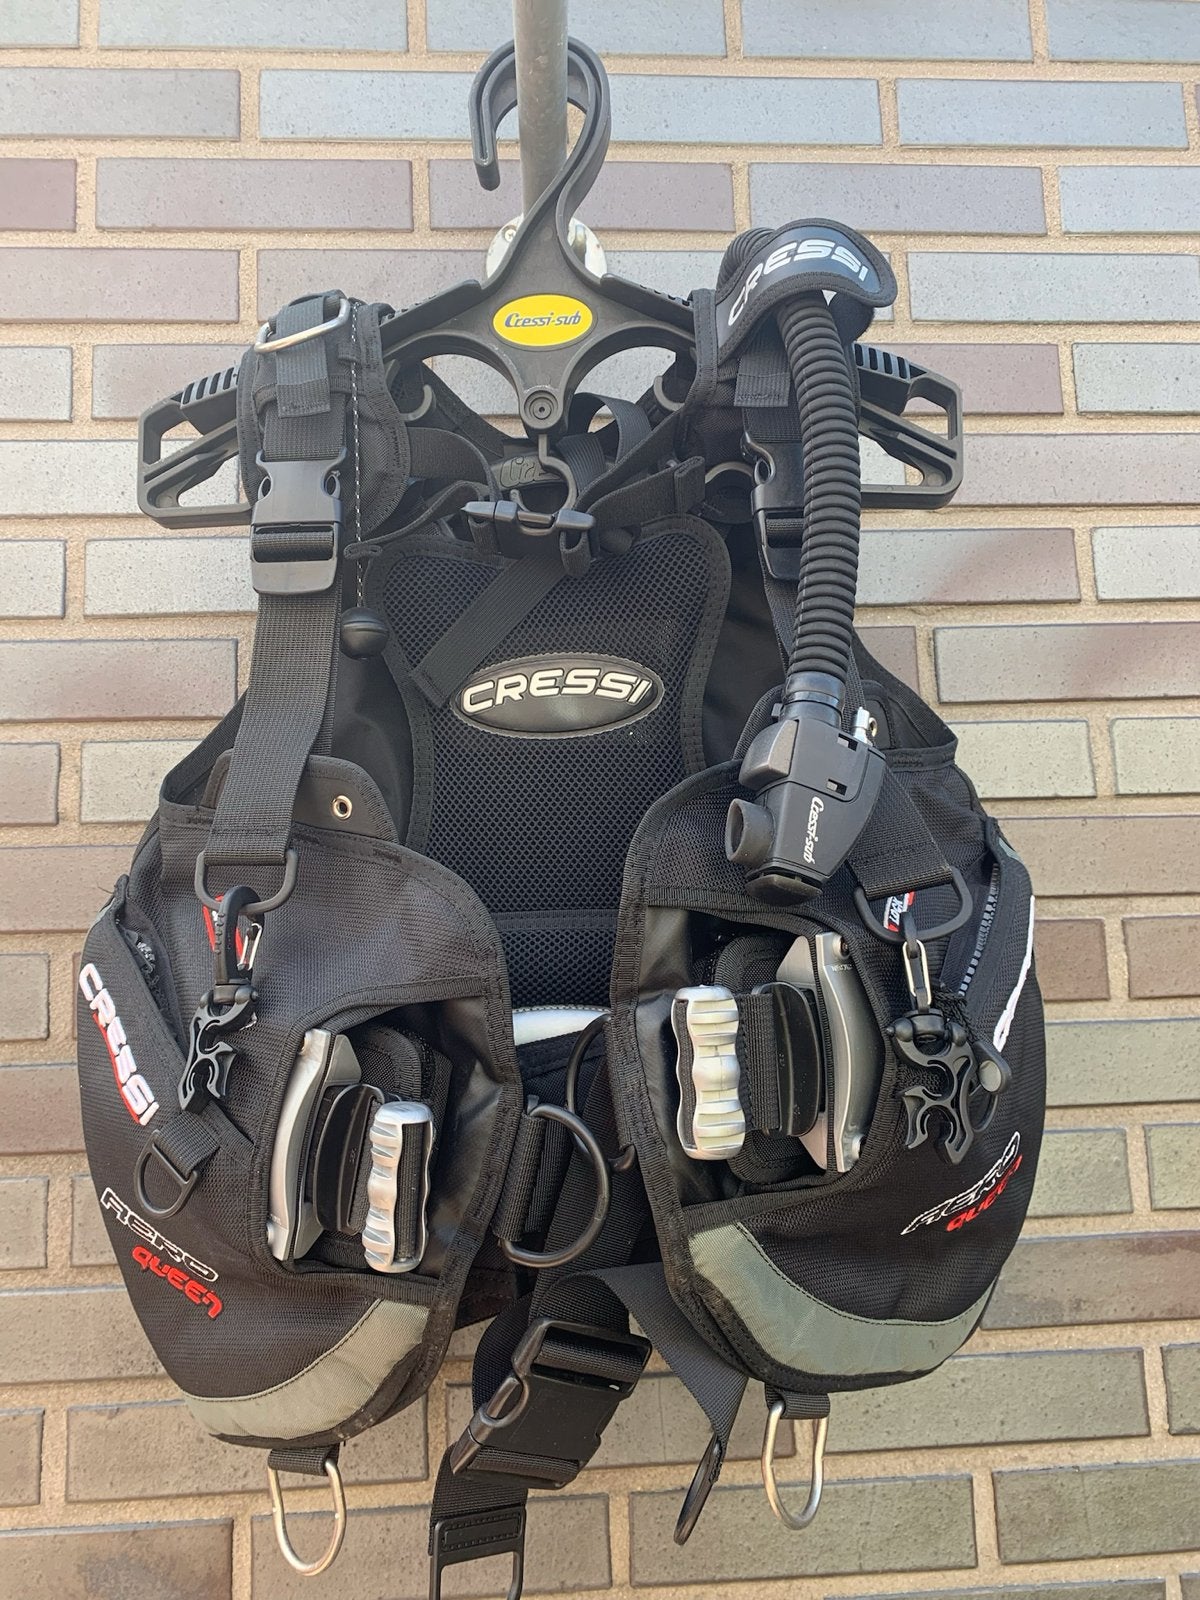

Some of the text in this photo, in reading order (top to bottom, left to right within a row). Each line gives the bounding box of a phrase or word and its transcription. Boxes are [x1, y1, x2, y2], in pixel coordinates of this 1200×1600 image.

[505, 311, 581, 328] Cressi-sub
[728, 239, 868, 326] CRESSI
[463, 668, 652, 714] CRESSI
[803, 796, 824, 864] Cressi-sub
[79, 963, 159, 1126] CRESSI
[100, 1187, 219, 1282] AERO
